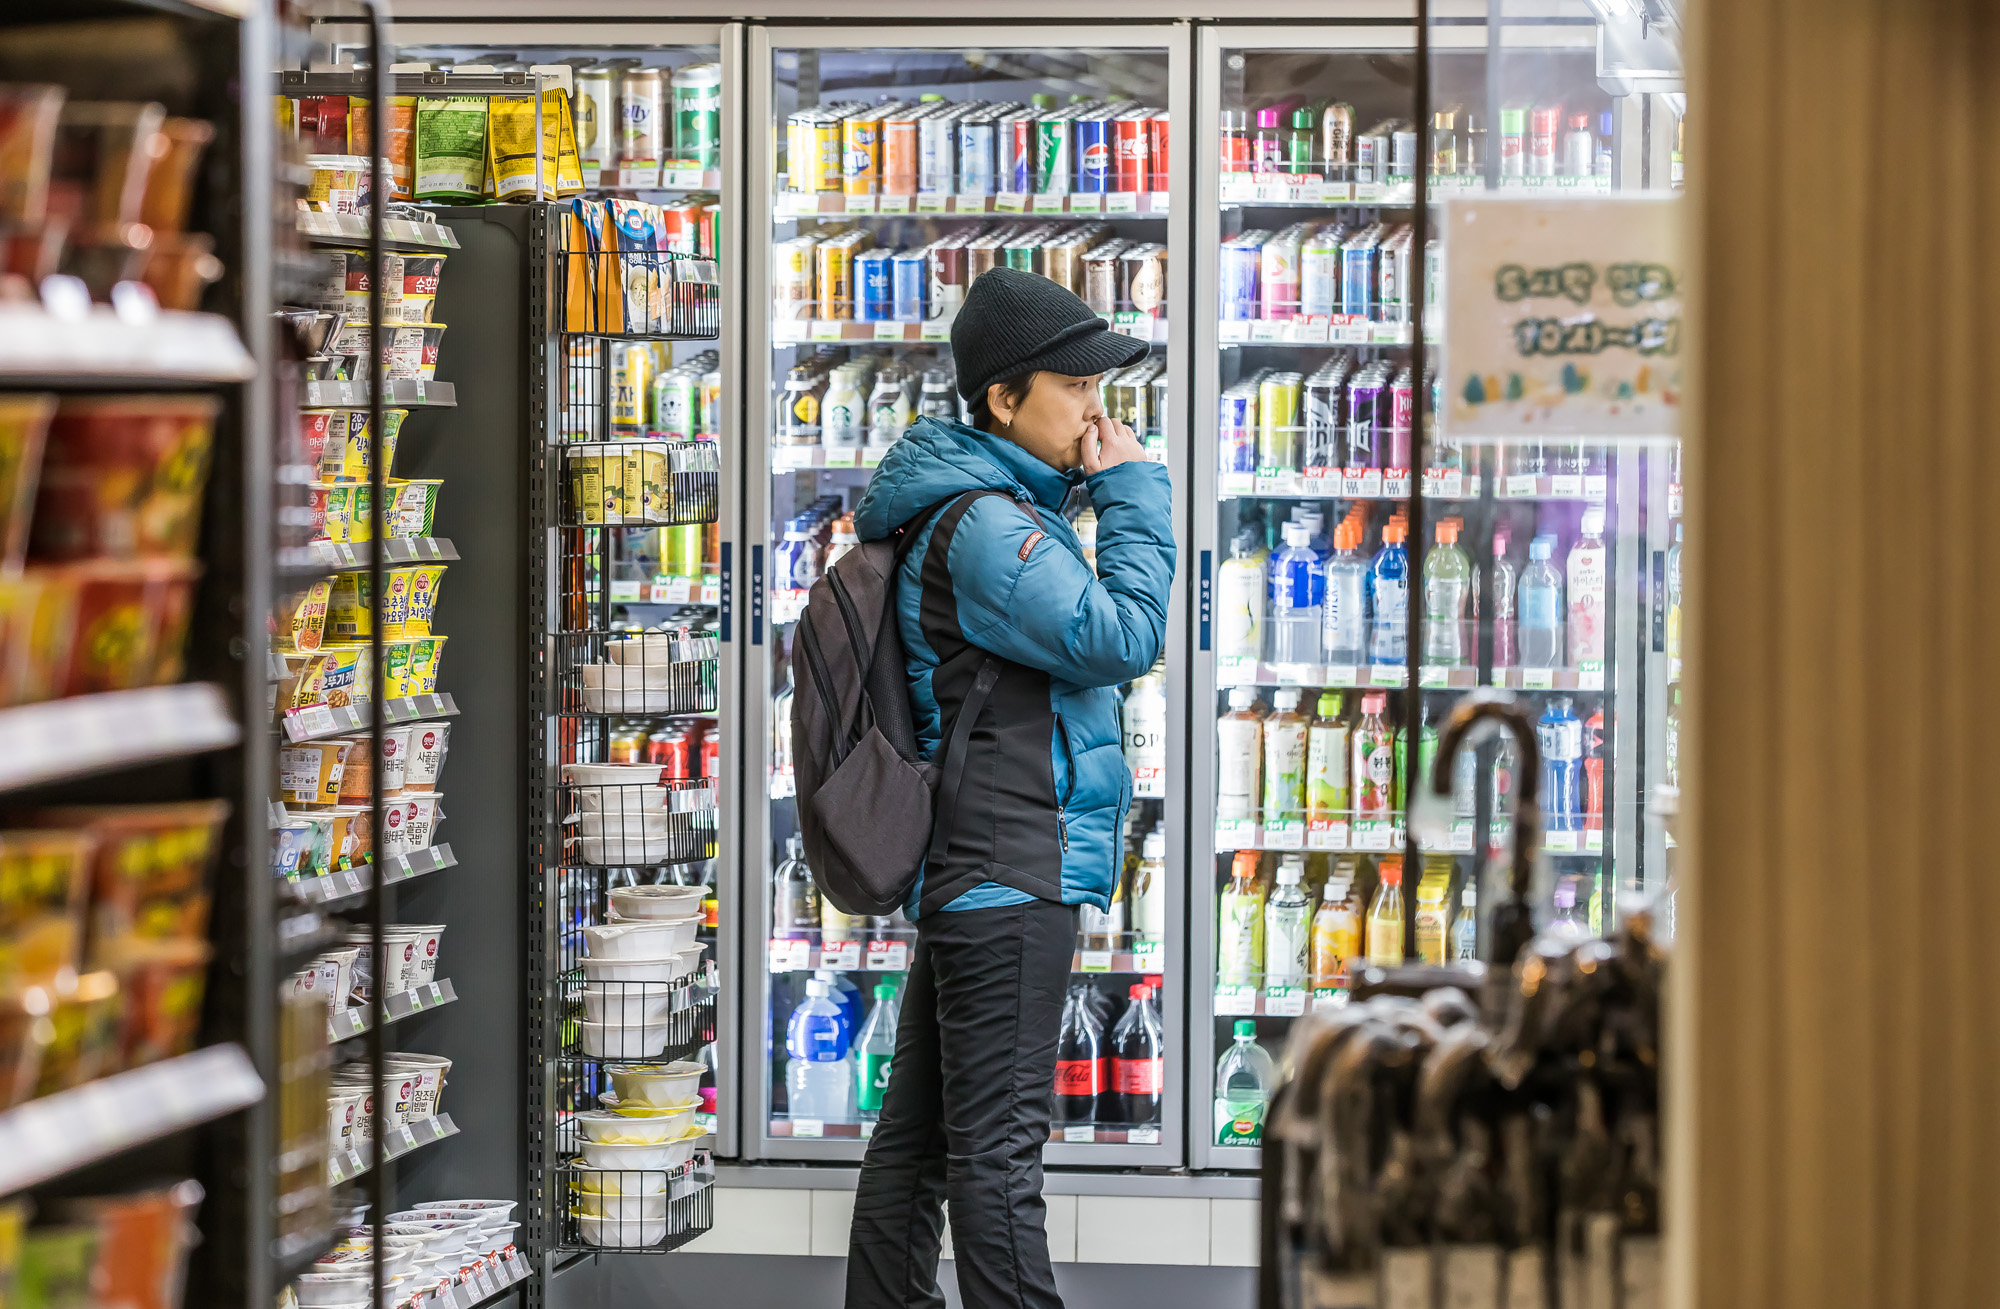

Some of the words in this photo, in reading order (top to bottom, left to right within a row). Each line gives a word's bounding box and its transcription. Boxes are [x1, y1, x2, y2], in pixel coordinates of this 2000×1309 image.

[350, 422, 363, 432] UP
[653, 575, 673, 585] 1+1
[1200, 579, 1210, 622] 당기세요
[1655, 581, 1663, 623] 당기세요
[1581, 662, 1599, 672] 1+1
[406, 821, 429, 834] 골곰탕
[1266, 821, 1283, 831] 1+1
[1311, 821, 1328, 830] 2+1
[1355, 821, 1372, 831] 1+1
[1268, 988, 1285, 997] 1+1
[873, 1061, 893, 1089] S
